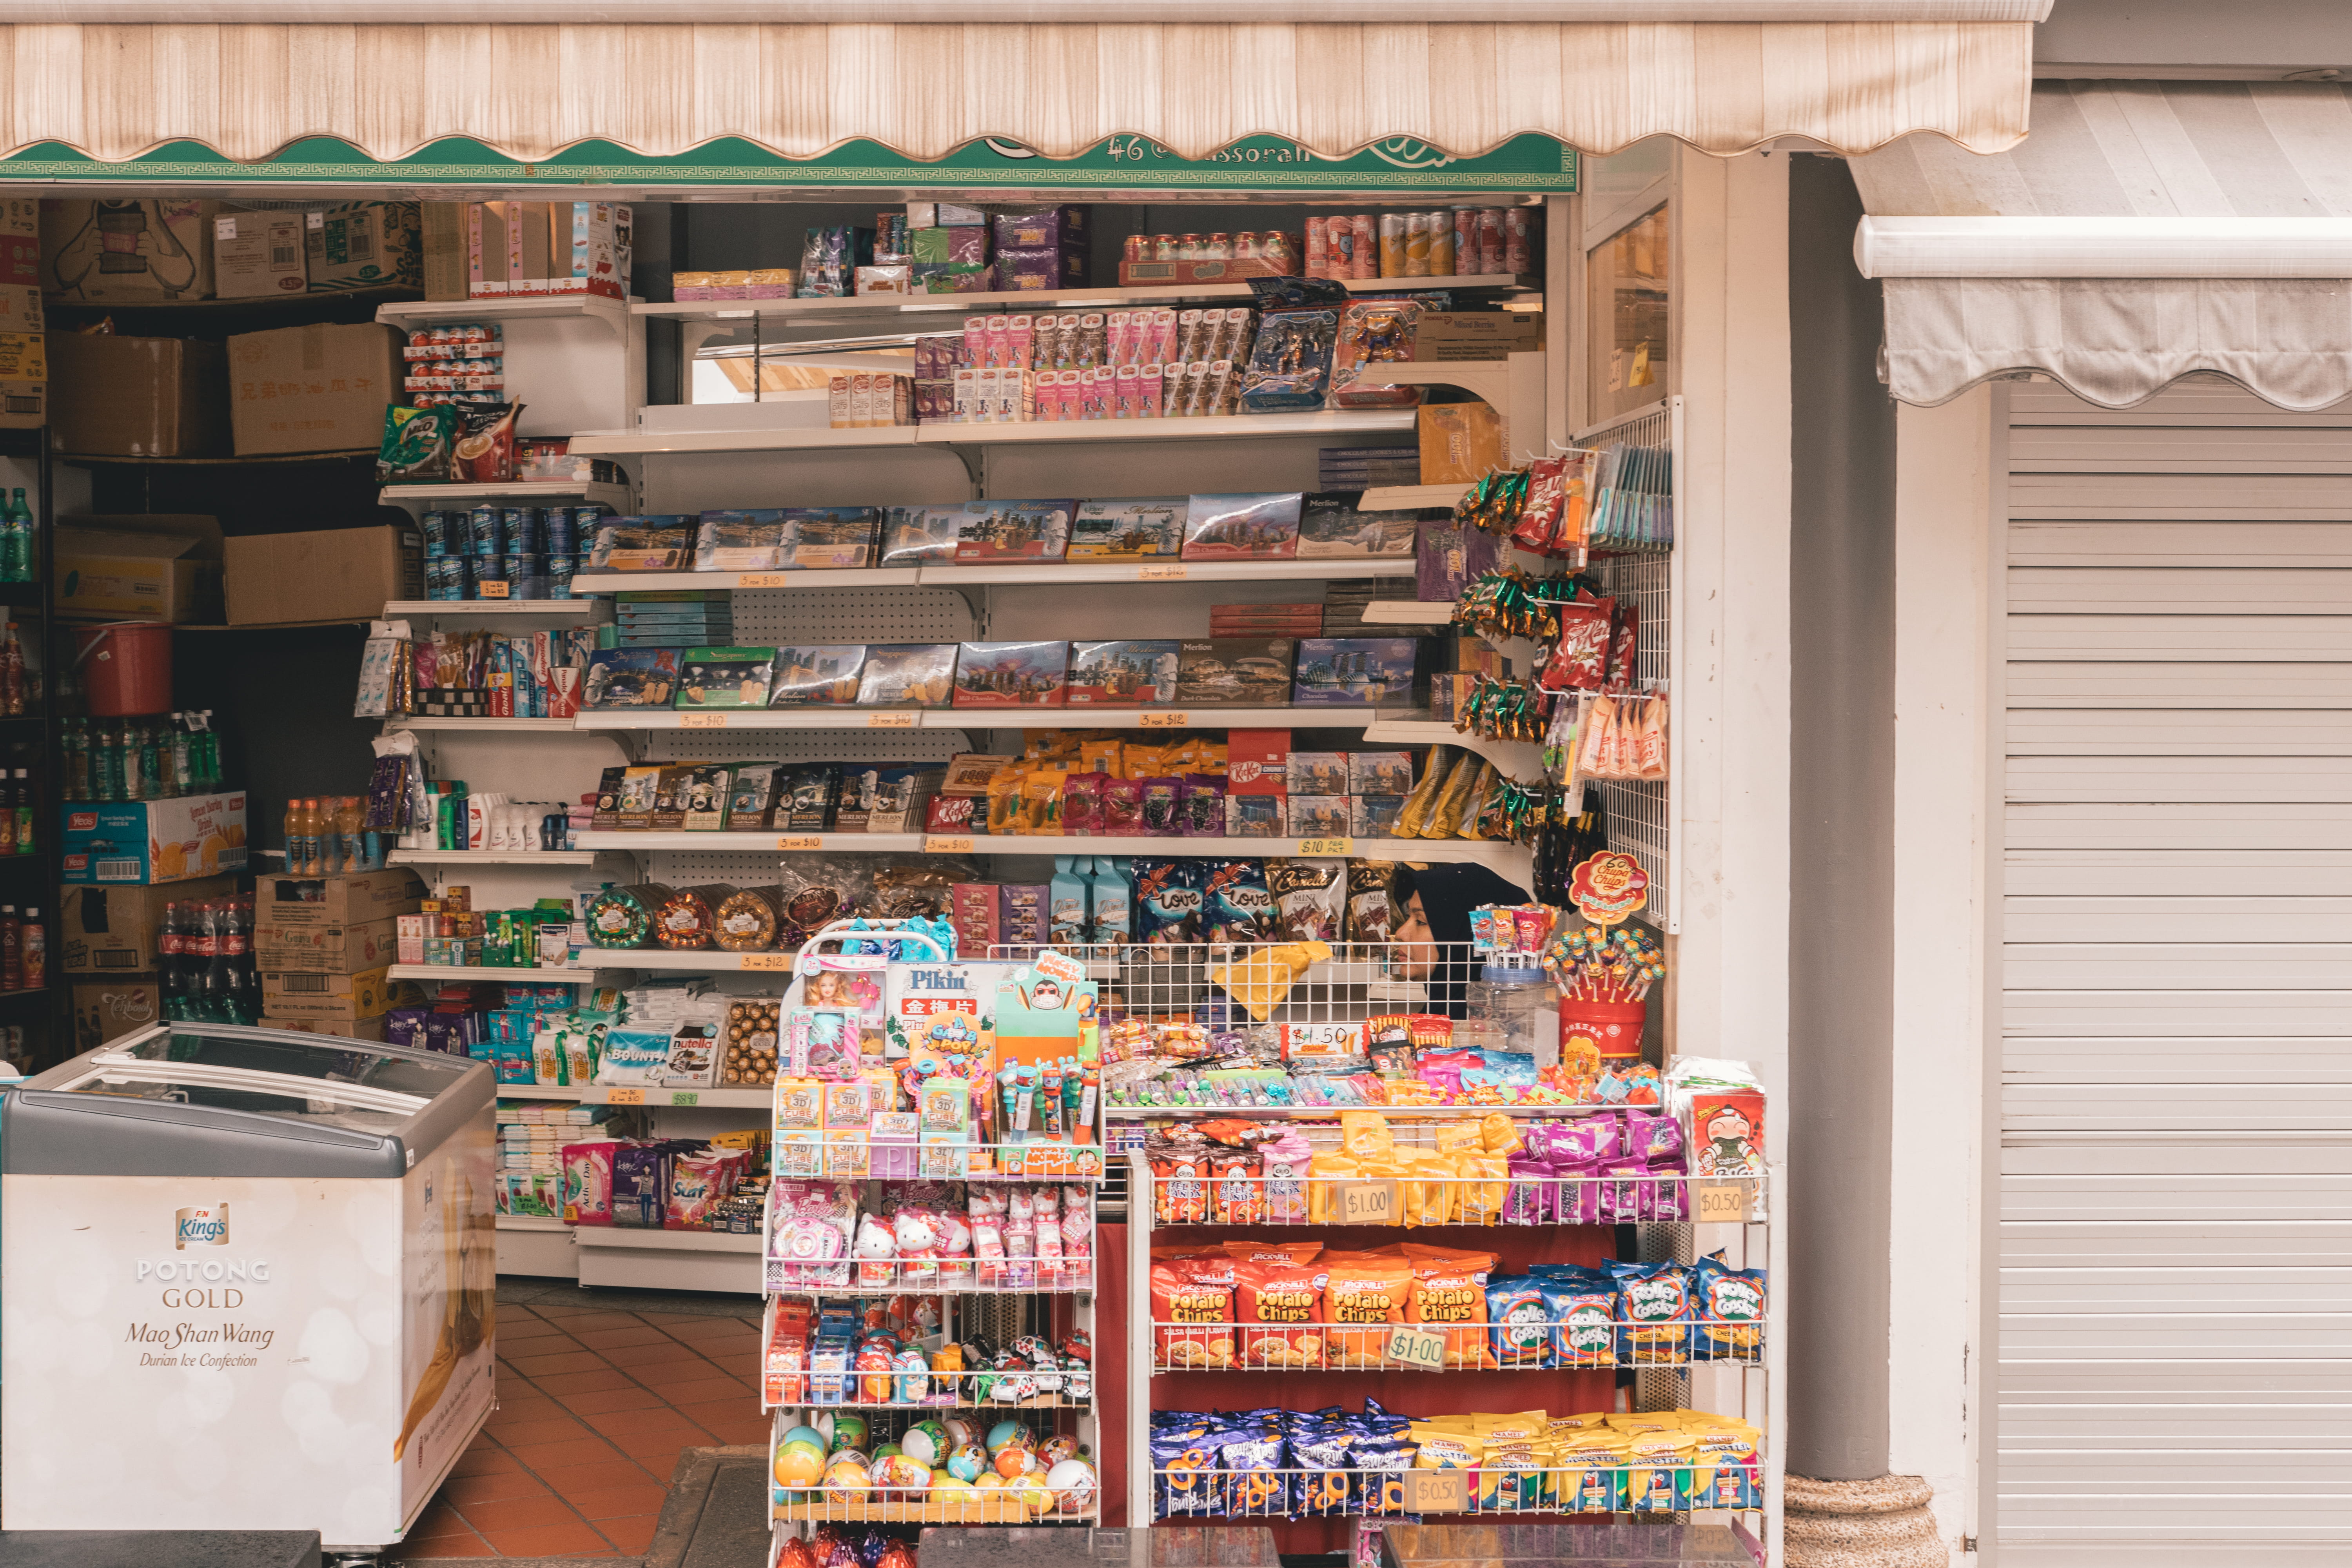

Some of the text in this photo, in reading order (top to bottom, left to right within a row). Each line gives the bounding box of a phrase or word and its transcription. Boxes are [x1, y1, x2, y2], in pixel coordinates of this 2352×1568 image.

[1106, 136, 1143, 162] 46
[440, 562, 463, 572] OREO
[550, 562, 572, 570] OREO
[1141, 568, 1149, 577] 3
[1166, 566, 1184, 576] $12
[741, 577, 748, 585] 3
[763, 577, 780, 585] $10
[683, 716, 690, 725] 3
[706, 715, 724, 726] $10
[872, 715, 878, 725] 3
[895, 714, 911, 724] $10
[1141, 715, 1149, 725] 3
[1167, 714, 1184, 725] $12
[780, 838, 787, 847] 3
[803, 838, 820, 847] $10
[929, 839, 936, 849] 3
[952, 840, 969, 849] $10
[1301, 841, 1323, 853] $10
[1598, 865, 1628, 877] Chupa
[1594, 874, 1626, 890] Chups
[742, 957, 750, 967] 3
[763, 956, 783, 967] $12
[911, 970, 965, 989] Pikin
[903, 1020, 925, 1030] Plu
[673, 1038, 713, 1049] nutella
[1292, 1027, 1347, 1045] $1.50
[612, 1049, 666, 1062] BOUNTY
[674, 1094, 698, 1104] $8.90
[793, 1098, 806, 1107] 3D
[842, 1096, 855, 1105] 3D
[937, 1102, 950, 1111] 3D
[673, 1181, 706, 1199] Surf
[904, 1182, 941, 1199] Barbie
[1219, 1192, 1255, 1201] PANDA
[796, 1197, 835, 1216] Barbie
[1347, 1191, 1386, 1215] $1.00
[1702, 1194, 1740, 1212] $0.50
[178, 1218, 225, 1241] King's
[136, 1258, 270, 1282] POTONG
[163, 1289, 243, 1308] GOLD
[1417, 1290, 1475, 1306] Potato
[1630, 1281, 1680, 1302] Roller
[1715, 1281, 1763, 1303] Roller
[1169, 1294, 1226, 1310] Potato
[1255, 1292, 1314, 1308] Potato
[1333, 1292, 1391, 1308] Potato
[1171, 1308, 1224, 1323] Chips
[1256, 1306, 1310, 1323] Chips
[1334, 1306, 1387, 1323] Chips
[1419, 1304, 1472, 1322] Chips
[1632, 1298, 1680, 1319] Coaster
[1715, 1298, 1760, 1319] Coaster
[125, 1323, 274, 1350] Mao Shan Wang
[1639, 1332, 1662, 1341] CHEESE
[1716, 1330, 1738, 1339] CHEESE
[1391, 1333, 1443, 1363] $1.00
[140, 1353, 258, 1371] Durian Ice Confection
[1433, 1441, 1463, 1450] MAMEE
[1699, 1443, 1751, 1452] MONSTER
[1418, 1450, 1474, 1461] MONSTER
[1565, 1455, 1622, 1464] MONSTER
[1418, 1481, 1457, 1501] $0.50
